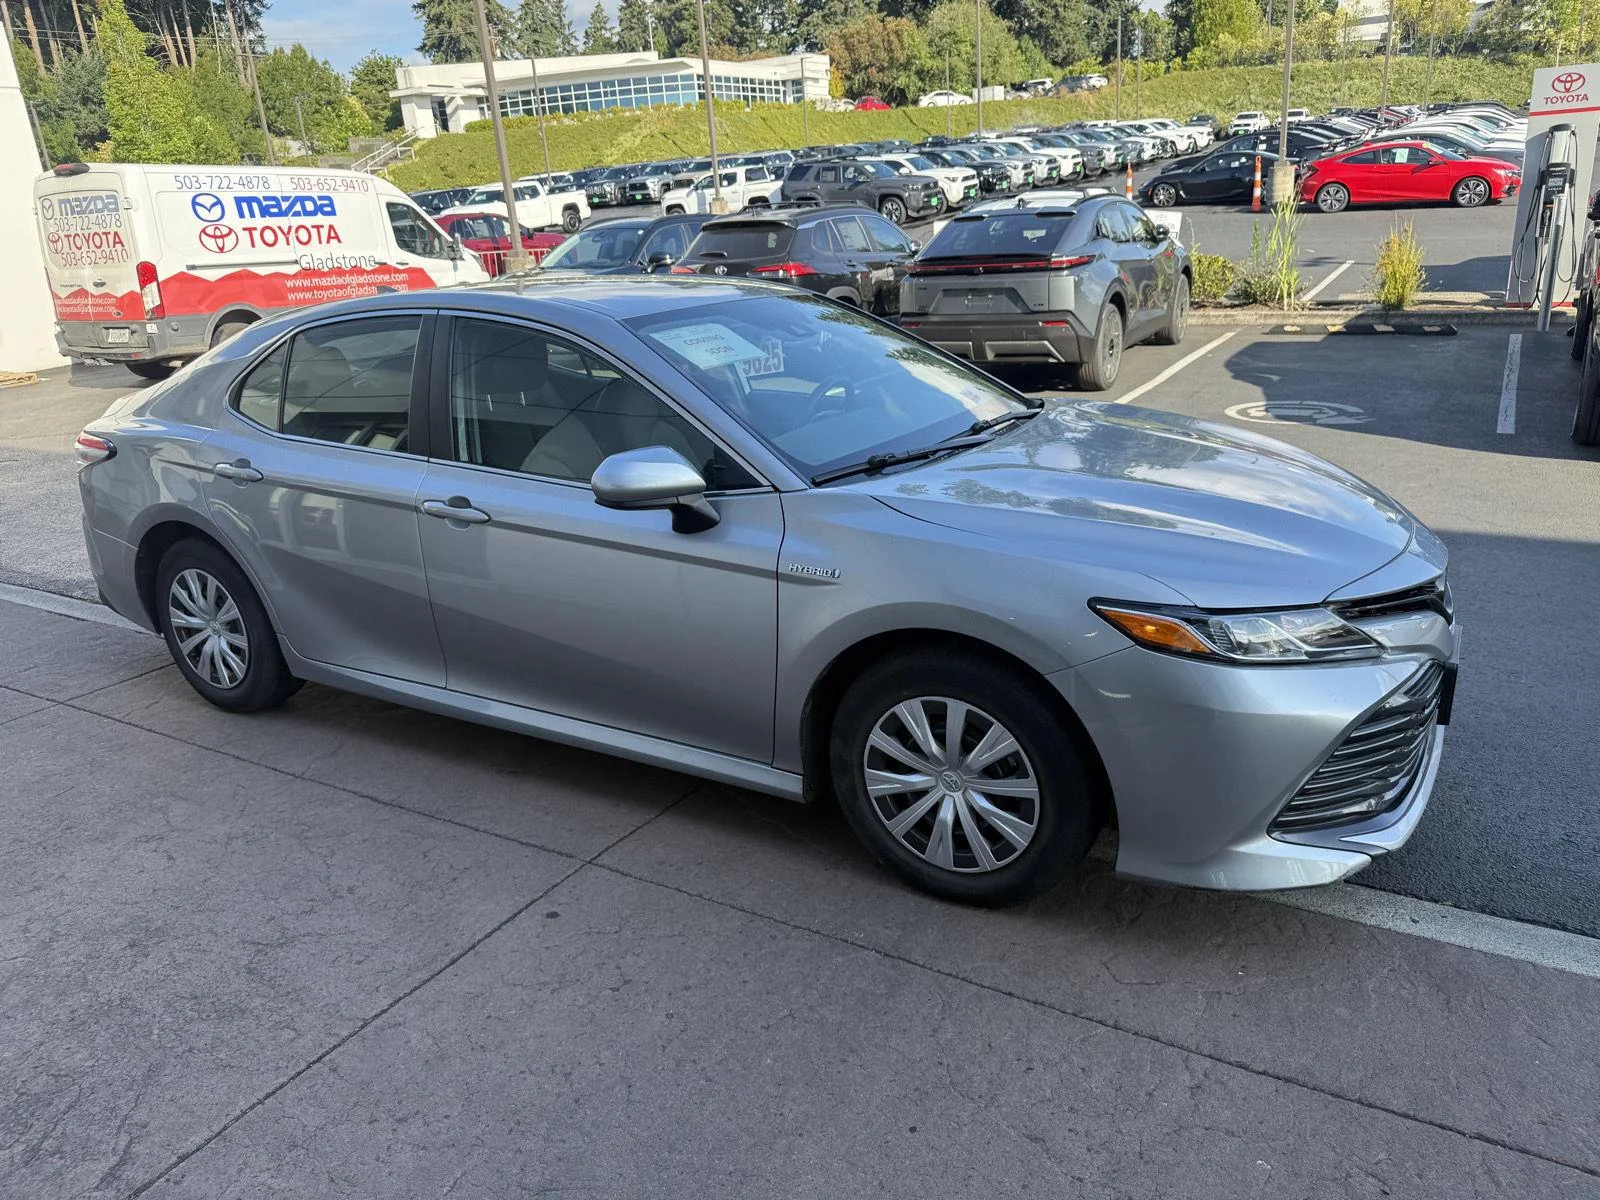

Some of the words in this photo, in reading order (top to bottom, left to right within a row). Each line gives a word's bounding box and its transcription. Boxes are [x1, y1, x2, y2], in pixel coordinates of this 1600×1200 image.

[1543, 93, 1589, 105] TOYOTA
[174, 175, 271, 190] 503-722-4878
[290, 177, 369, 192] 503-652-9410
[233, 195, 337, 219] mazda
[53, 213, 122, 232] 503-722-4878
[64, 230, 125, 251] TOYOTA
[242, 224, 342, 248] TOYOTA
[61, 248, 129, 267] 503-652-9410
[299, 252, 376, 271] Gladstone
[285, 272, 409, 289] www.mazdaofgladstone.com
[287, 283, 409, 301] www.toyotaofgladstom
[788, 563, 832, 577] HYBRID
